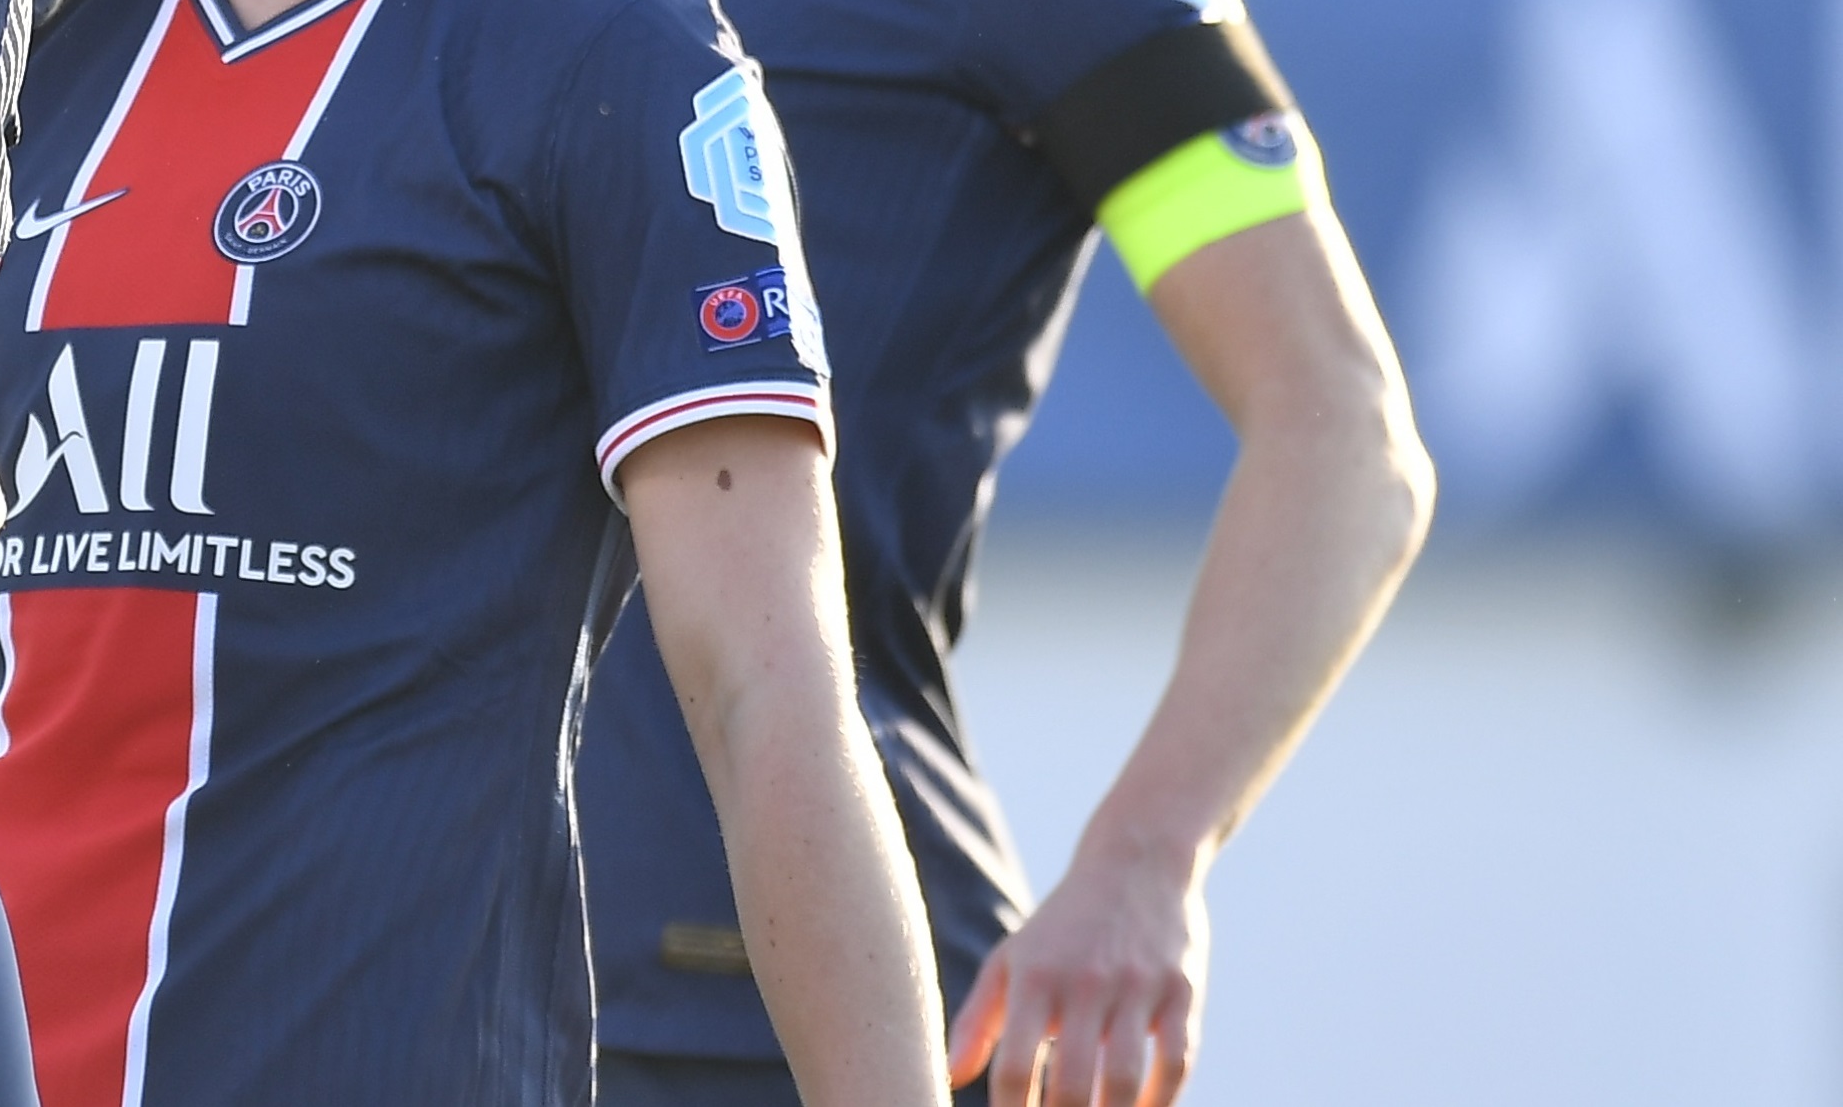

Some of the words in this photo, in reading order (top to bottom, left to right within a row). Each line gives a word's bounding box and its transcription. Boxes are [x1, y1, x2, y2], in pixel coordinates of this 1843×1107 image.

[247, 169, 312, 197] PARIS
[708, 290, 743, 306] UEFA
[29, 532, 113, 575] LIVE
[117, 530, 356, 589] LIMITLESS
